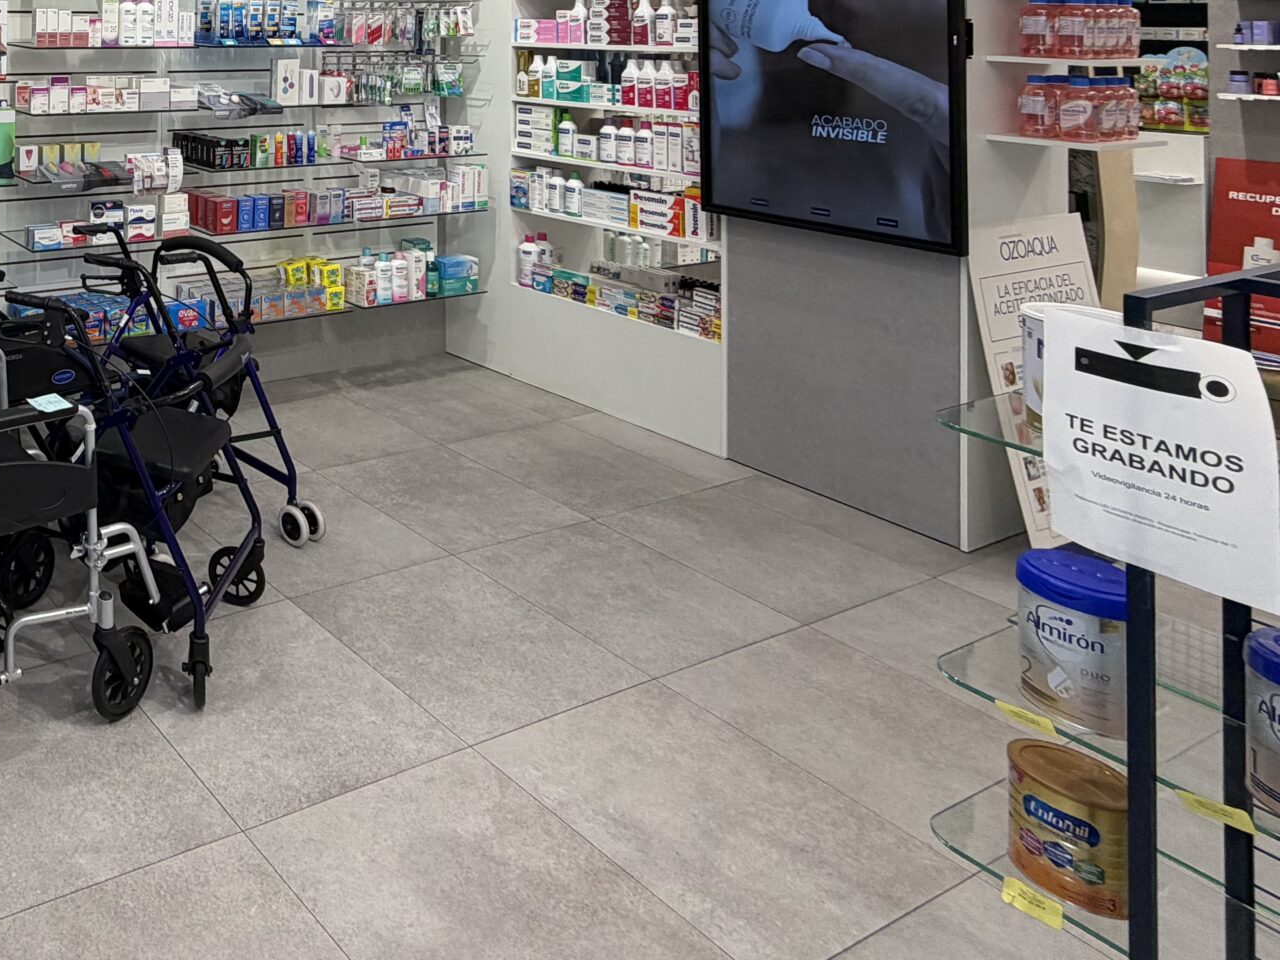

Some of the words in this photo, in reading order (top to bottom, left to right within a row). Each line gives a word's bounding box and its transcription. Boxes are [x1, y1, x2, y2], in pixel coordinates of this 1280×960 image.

[811, 114, 888, 132] ACABADO
[811, 125, 888, 144] INVISIBLE
[633, 192, 667, 205] Desensin
[639, 207, 668, 218] Desensin
[639, 219, 668, 230] Desensin
[691, 203, 699, 236] Desensin
[999, 235, 1059, 261] OZOAQUA
[996, 284, 1011, 299] LA
[1011, 276, 1055, 296] EFICACIA
[1055, 273, 1076, 288] DEL
[1064, 412, 1095, 436] TE
[1102, 424, 1245, 473] ESTAMOS
[1072, 437, 1236, 494] GRABANDO
[1091, 470, 1162, 498] Videovigilancia
[1164, 492, 1178, 502] 24
[1179, 497, 1211, 512] horas
[1026, 610, 1106, 655] Almirón
[1022, 655, 1033, 682] 2
[1029, 800, 1090, 838] Enfamil
[1106, 898, 1117, 912] 3
